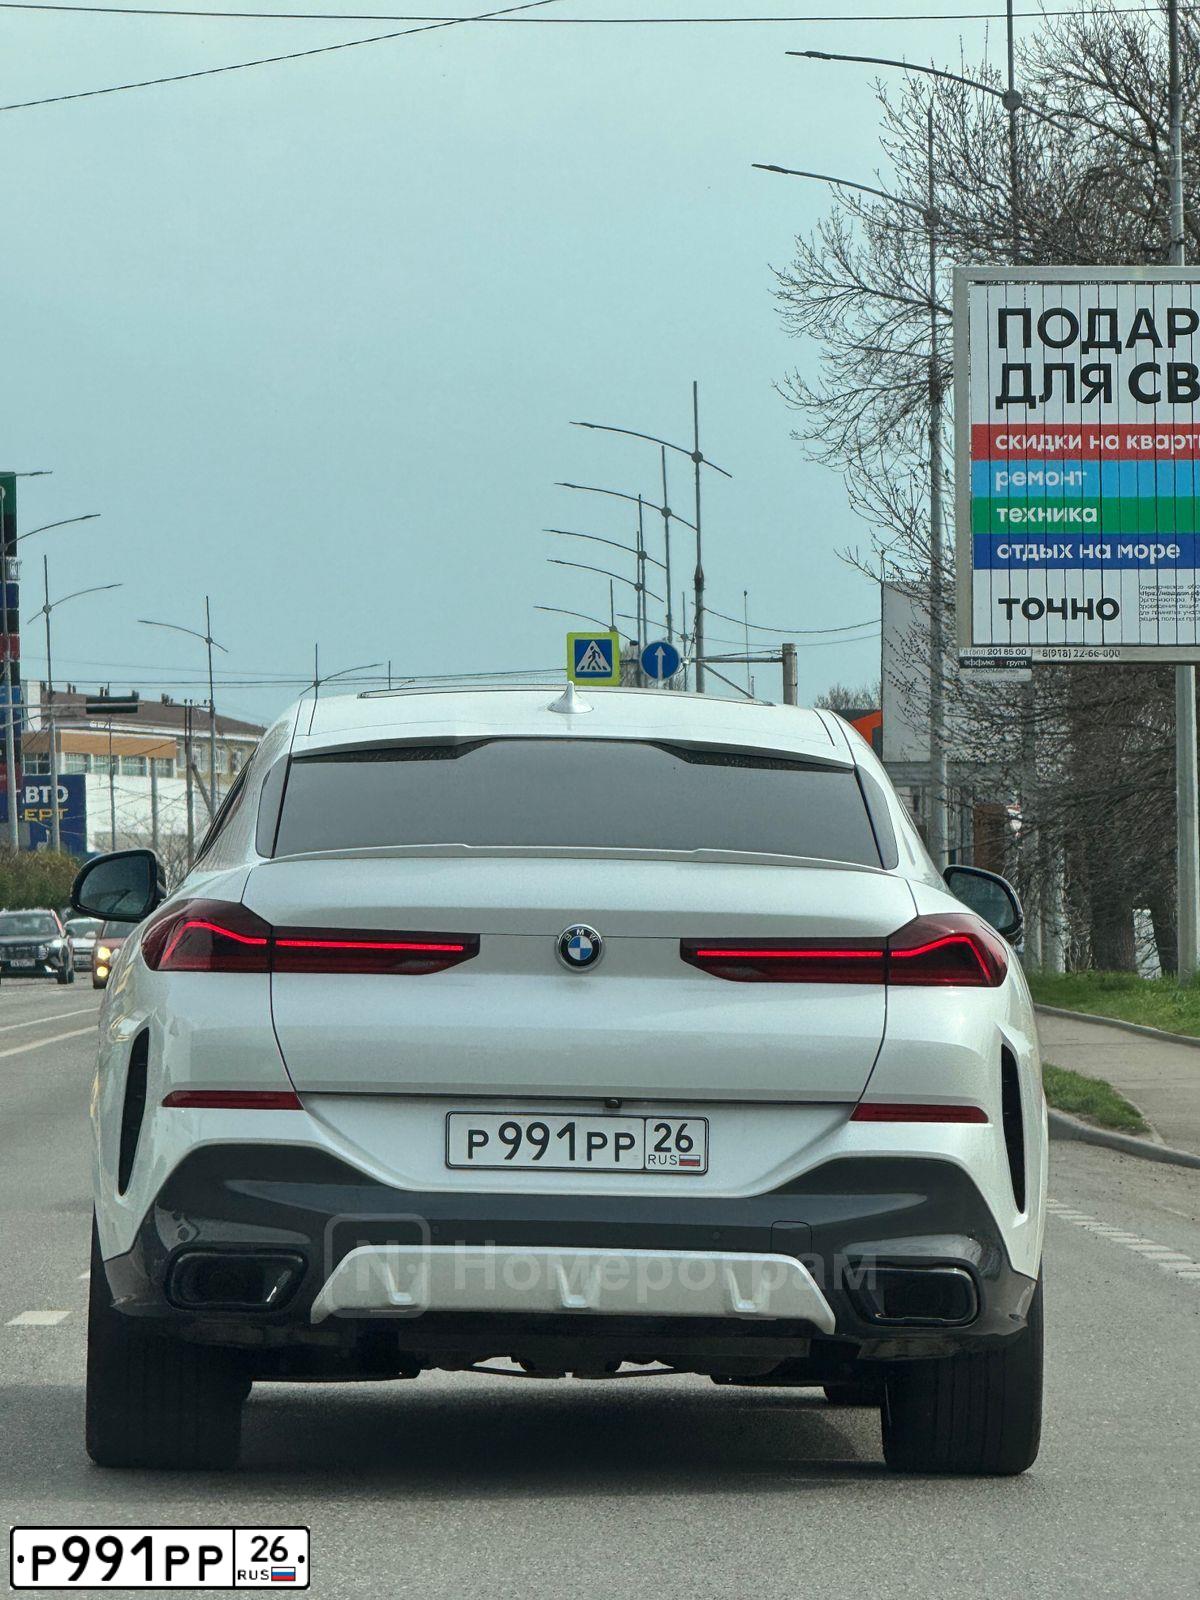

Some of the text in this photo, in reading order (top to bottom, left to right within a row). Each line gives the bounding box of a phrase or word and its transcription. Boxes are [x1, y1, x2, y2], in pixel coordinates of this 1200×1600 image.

[998, 308, 1200, 354] ПОДАР
[996, 362, 1200, 409] ДЛЯ СВ
[995, 434, 1200, 455] скидки на кварт
[995, 471, 1087, 491] ремонт
[997, 507, 1098, 523] техника
[997, 544, 1180, 564] отдых на море
[564, 928, 599, 942] BMW
[653, 1122, 694, 1153] 26
[648, 1154, 678, 1166] RUS
